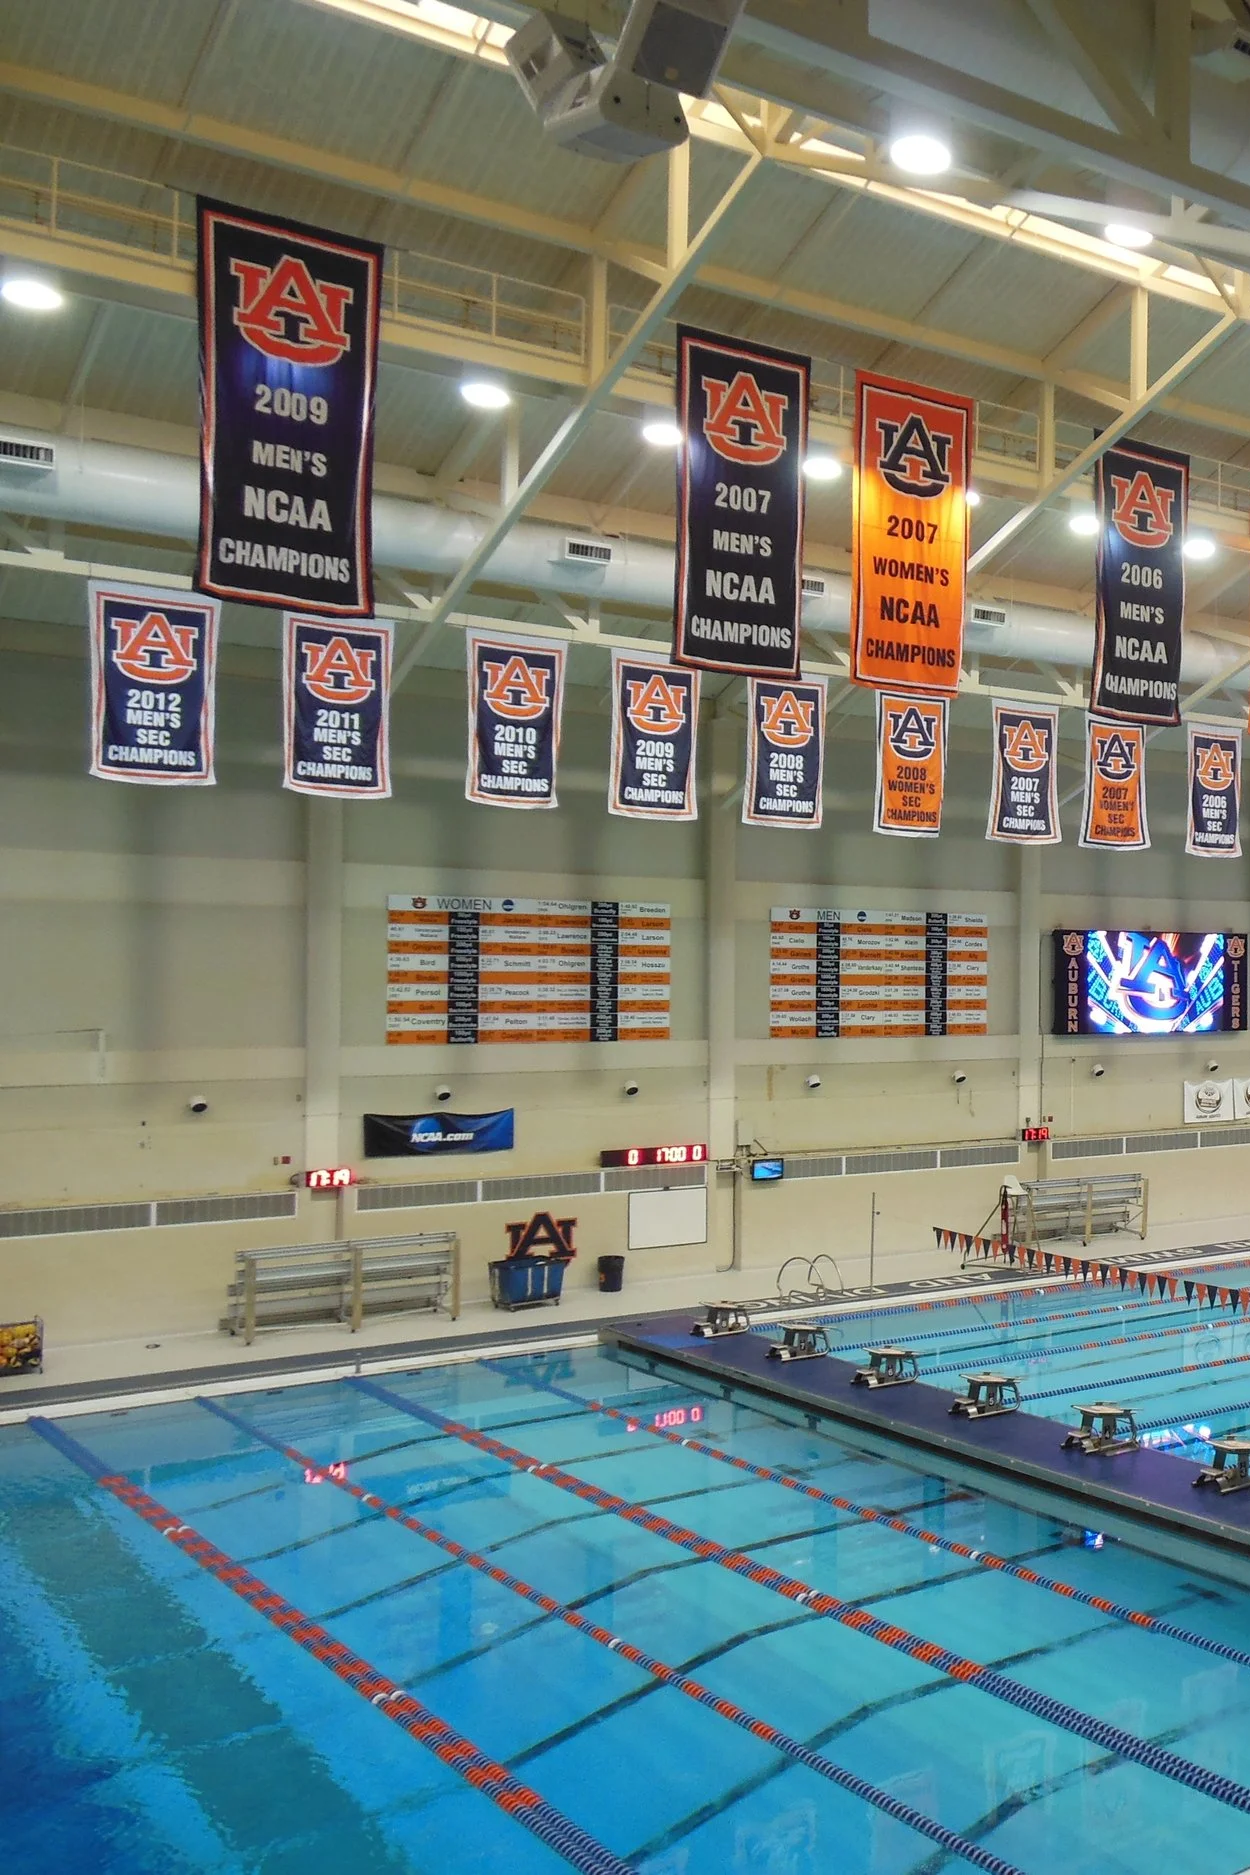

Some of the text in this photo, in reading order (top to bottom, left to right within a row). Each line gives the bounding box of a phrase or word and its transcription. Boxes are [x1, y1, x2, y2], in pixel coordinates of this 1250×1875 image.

[255, 384, 329, 425] 2009
[252, 440, 327, 477] MEN'S
[715, 483, 771, 514] 2007
[244, 485, 332, 532] NCAA
[887, 515, 938, 545] 2007
[712, 529, 772, 557] MEN'S
[219, 536, 350, 583] CHAMPIONS
[873, 556, 949, 587] WOMEN'S
[1120, 562, 1163, 590] 2006
[706, 569, 775, 605] NCAA
[880, 595, 939, 628] NCAA
[1120, 601, 1164, 624] MEN'S
[691, 615, 791, 649] CHAMPIONS
[866, 638, 955, 668] CHAMPIONS
[1115, 636, 1168, 664] NCAA
[127, 689, 181, 712] 2012
[127, 709, 181, 729] MEN'S
[316, 709, 360, 730] 2011
[136, 729, 170, 746] SEC
[313, 727, 361, 746] MEN'S
[494, 724, 536, 744] 2010
[108, 745, 196, 767] CHAMPIONS
[323, 746, 352, 762] SEC
[494, 742, 535, 759] MEN'S
[636, 739, 674, 758] 2009
[502, 759, 527, 774] SEC
[635, 756, 674, 772] MEN'S
[770, 752, 803, 770] 2008
[297, 761, 372, 781] CHAMPIONS
[643, 772, 666, 787] SEC
[770, 768, 803, 783] MEN'S
[896, 766, 926, 781] 2008
[481, 774, 549, 792] CHAMPIONS
[776, 784, 797, 797] SEC
[888, 780, 935, 794] WOMEN'S
[1011, 776, 1039, 791] 2007
[624, 787, 683, 804] CHAMPIONS
[902, 796, 921, 807] SEC
[1011, 790, 1040, 804] MEN'S
[1102, 787, 1128, 799] 2007
[1202, 794, 1226, 809] 2006
[759, 797, 813, 813] CHAMPIONS
[1016, 804, 1035, 817] SEC
[1202, 807, 1227, 820] MEN'S
[887, 808, 937, 823] CHAMPIONS
[1003, 816, 1046, 831] CHAMPIONS
[1108, 814, 1124, 824] SEC
[1207, 820, 1223, 831] SEC
[436, 898, 492, 910] WOMEN
[817, 910, 840, 920] MEN
[1068, 957, 1079, 1033] AUBURN
[1231, 959, 1241, 1030] TIGERS
[410, 1131, 474, 1143] NCAA.com
[1024, 1128, 1048, 1140] 17:19
[656, 1146, 687, 1163] 17:00
